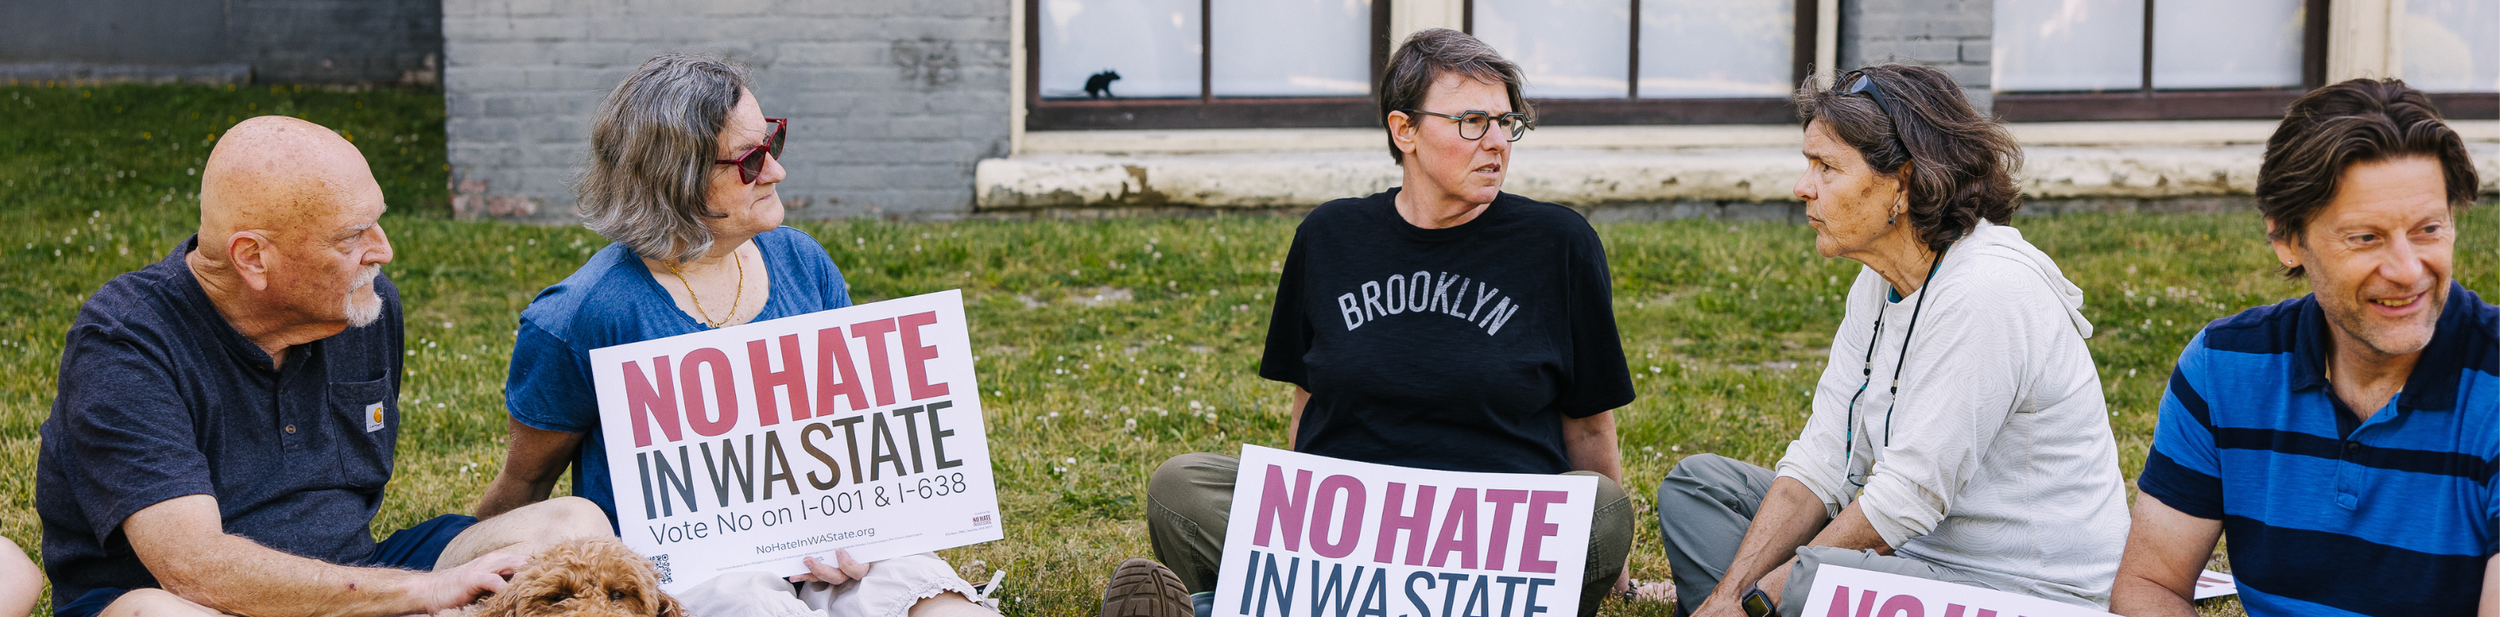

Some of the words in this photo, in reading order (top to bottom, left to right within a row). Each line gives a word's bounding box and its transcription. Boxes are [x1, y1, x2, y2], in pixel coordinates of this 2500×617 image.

[1338, 270, 1519, 336] BROOKLYN
[621, 347, 738, 448] NO
[746, 310, 950, 427] HATE
[636, 445, 698, 520] IN
[699, 430, 800, 508] WA
[800, 400, 963, 491] STATE
[649, 515, 708, 546] Vote
[717, 512, 753, 535] No
[762, 505, 793, 527] on
[801, 489, 865, 521] I-001
[874, 485, 891, 508] &
[898, 472, 967, 504] I-638
[756, 526, 876, 555] NoHateInWAState.org
[1252, 464, 1367, 558] NO
[1373, 481, 1569, 574] HATE
[1239, 550, 1300, 617] IN
[1310, 560, 1389, 617] WA
[1399, 571, 1556, 617] STATE
